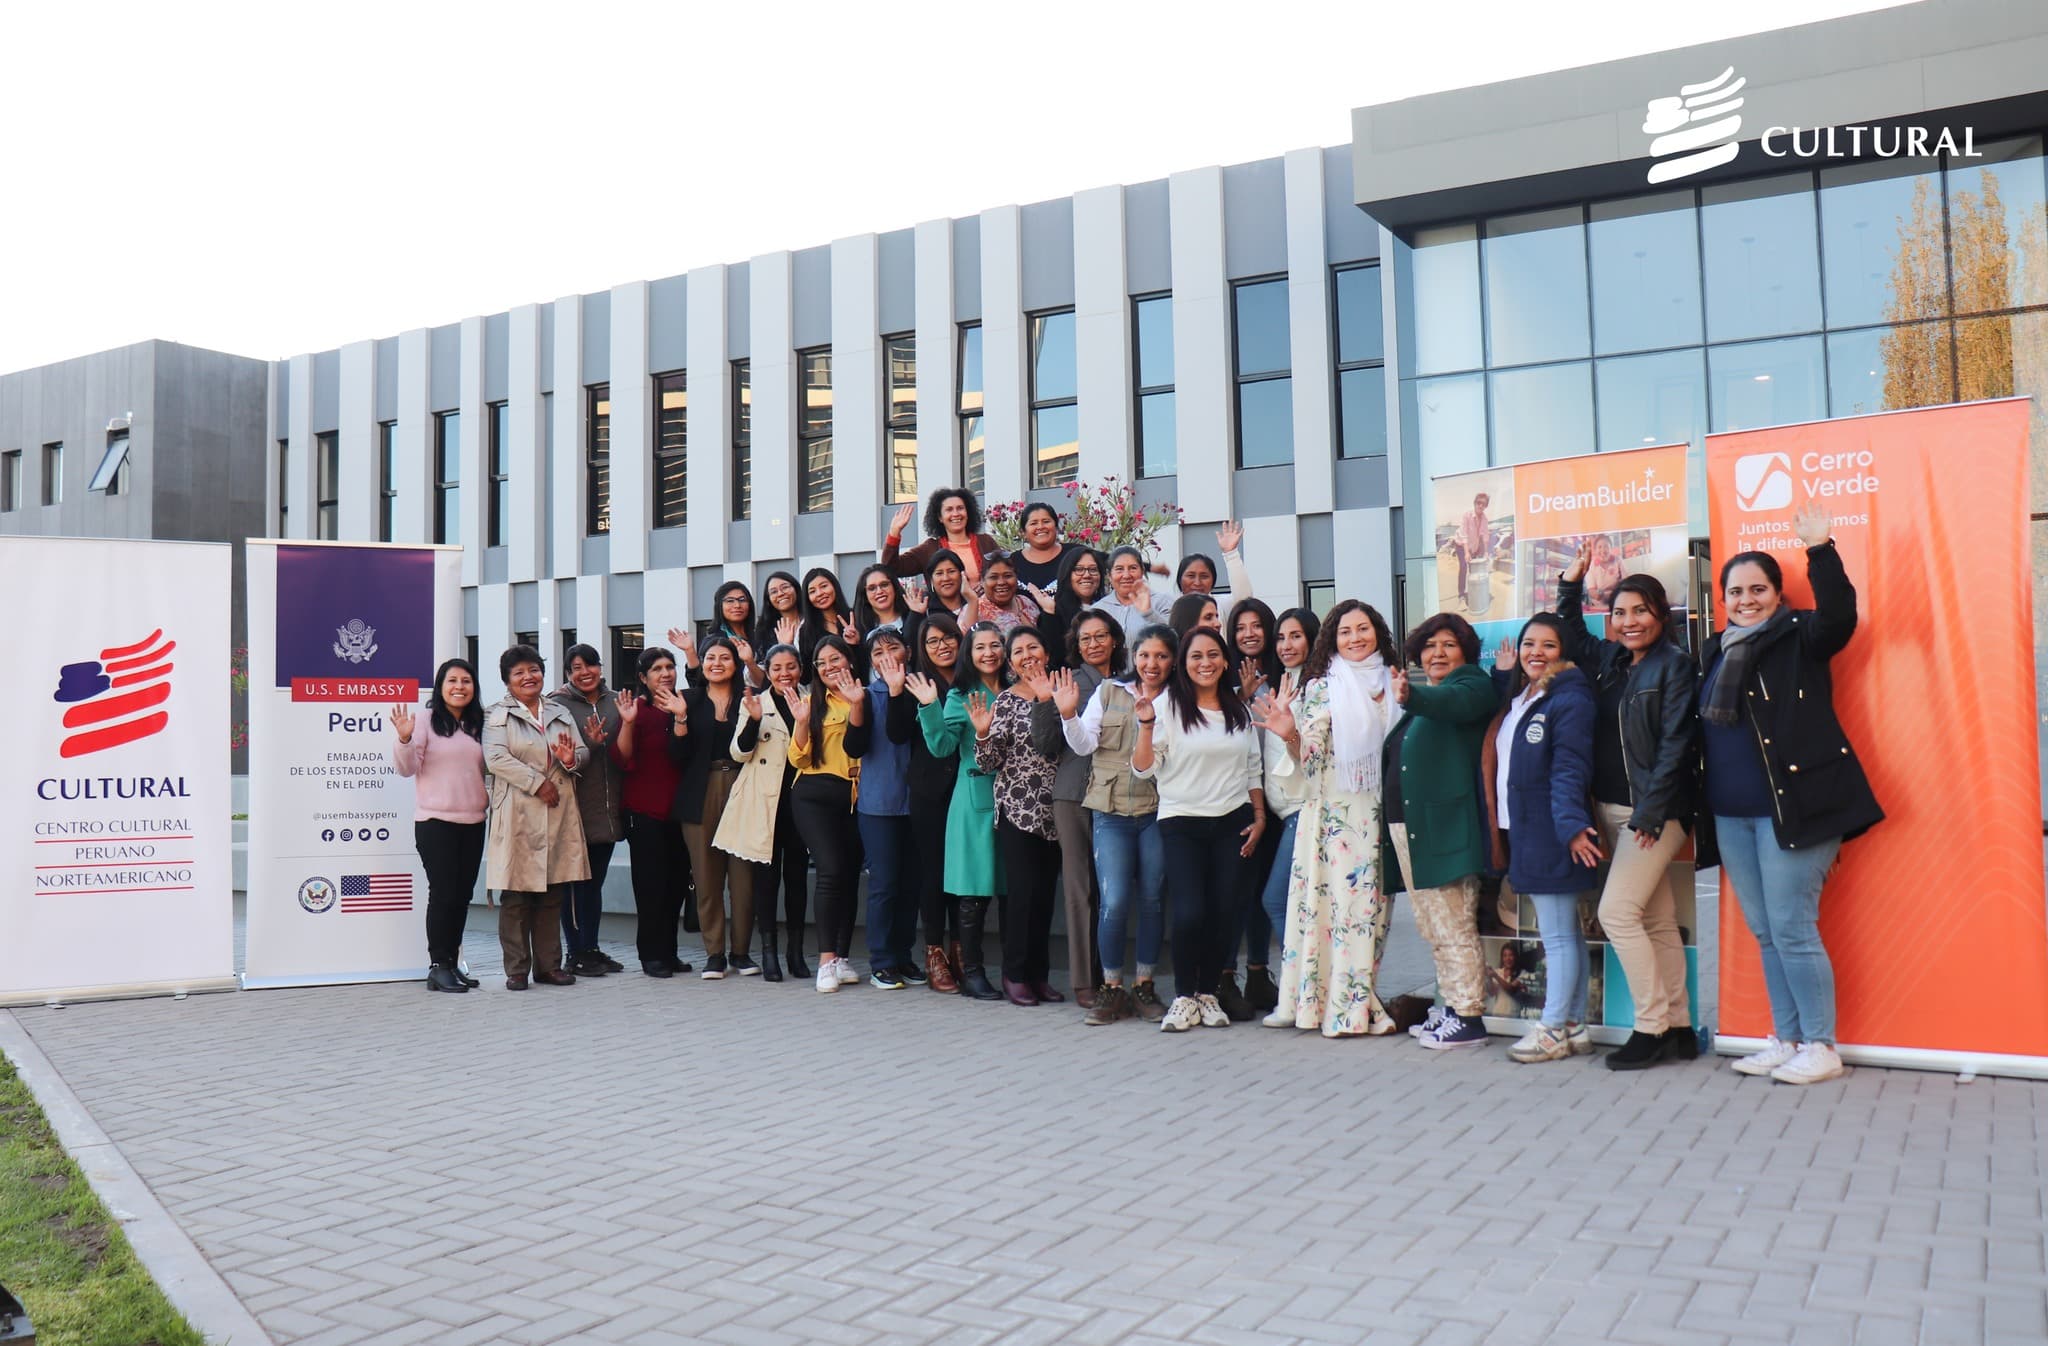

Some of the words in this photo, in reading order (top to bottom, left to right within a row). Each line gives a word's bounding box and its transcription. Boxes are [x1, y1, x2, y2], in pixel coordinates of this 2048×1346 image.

[1801, 450, 1873, 472] Cerro
[1802, 473, 1879, 498] Verde
[1528, 477, 1673, 514] DreamBuilder
[1738, 521, 1790, 535] Juntos
[1738, 539, 1751, 552] la
[305, 684, 333, 696] U.S.
[338, 684, 405, 696] EMBASSY
[329, 711, 382, 732] Perú
[327, 752, 384, 761] EMBAJADA
[290, 767, 303, 776] DE
[307, 767, 326, 775] LOS
[330, 766, 376, 775] ESTADOS
[37, 776, 191, 800] CULTURAL
[326, 780, 340, 789] EN
[344, 780, 355, 789] EL
[313, 810, 398, 821] @usembassyperu
[35, 820, 104, 835] CENTRO
[109, 818, 192, 833] CULTURAL
[75, 845, 155, 859] PERUANO
[36, 869, 192, 887] NORTEAMERICANO
